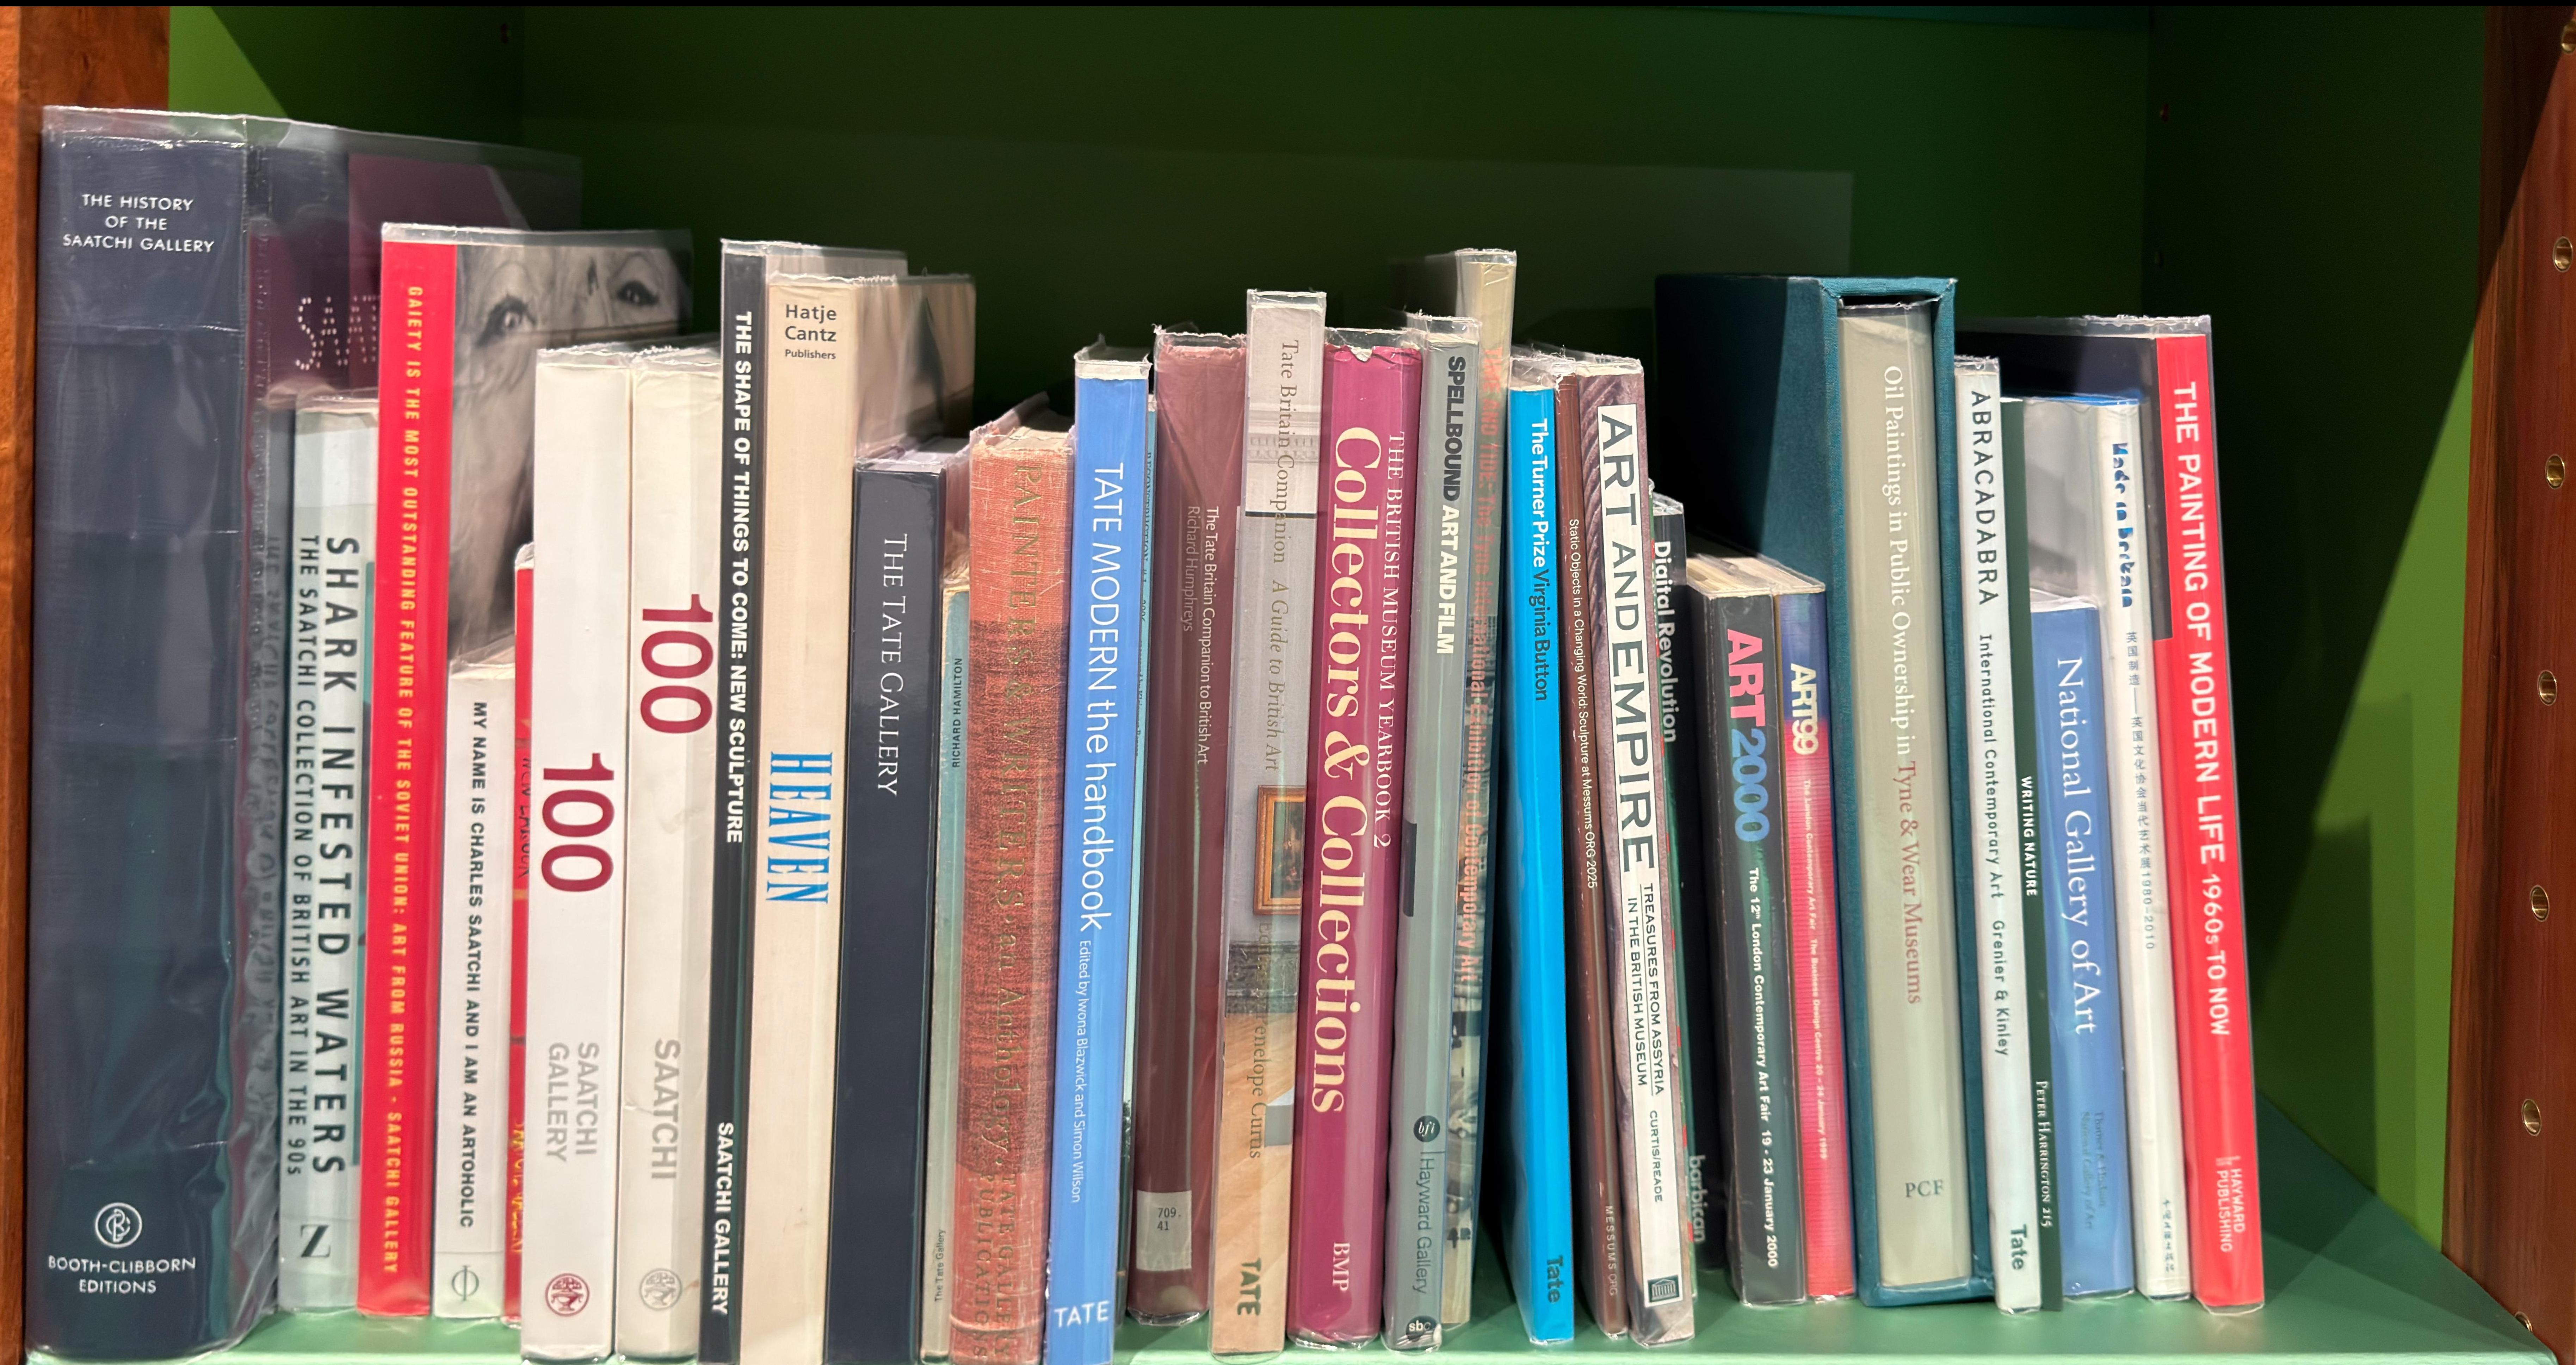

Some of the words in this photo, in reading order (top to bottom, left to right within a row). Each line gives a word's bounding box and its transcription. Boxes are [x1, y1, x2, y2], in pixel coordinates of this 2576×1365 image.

[82, 194, 112, 207] THE
[120, 196, 193, 211] HISTORY
[106, 217, 128, 229] OF
[136, 217, 167, 230] THE
[63, 235, 132, 249] SAATCHI
[141, 238, 214, 252] GALLERY
[735, 311, 752, 354] THE
[785, 304, 837, 322] Hatje
[785, 326, 837, 342] Cantz
[785, 348, 836, 360] Publishers
[734, 362, 752, 431] SHAPE
[1884, 365, 1904, 401] Oil
[1443, 356, 1466, 502] SPELLBOUND
[1532, 419, 1548, 455] The
[2174, 382, 2199, 443] THE
[734, 438, 750, 465] OF
[1388, 431, 1404, 480] THE
[1602, 413, 1637, 527] ART
[1882, 407, 1906, 506] Paintings
[732, 472, 750, 552] THINGS
[1093, 462, 1123, 532] TATE
[1532, 456, 1548, 517] Turner
[1972, 391, 1999, 605] ABRACADABRA
[1206, 506, 1219, 531] The
[1385, 488, 1402, 579] BRITISH
[1441, 505, 1459, 551] ART
[1532, 520, 1549, 568] Prize
[1570, 519, 1579, 550] Static
[1889, 511, 1907, 533] in
[2177, 455, 2207, 592] PAINTING
[301, 535, 319, 575] THE
[732, 559, 748, 586] TO
[883, 533, 908, 587] THE
[1205, 532, 1218, 561] Tate
[1326, 427, 1382, 717] Collectors
[1890, 539, 1911, 606] Public
[1204, 563, 1217, 607] Britain
[1439, 551, 1457, 599] AND
[1570, 553, 1581, 595] Objects
[1612, 541, 1639, 630] AND
[323, 537, 360, 692] SHARK
[730, 592, 748, 660] COME:
[1087, 543, 1121, 691] MODERN
[1437, 603, 1455, 654] FILM
[1528, 569, 1550, 637] Virginia
[1574, 598, 1582, 607] in
[2186, 602, 2211, 641] OF
[298, 589, 319, 686] SAATCHI
[882, 595, 906, 664] TATE
[1199, 609, 1215, 684] Companion
[1380, 587, 1400, 690] MUSEUM
[1574, 620, 1584, 672] Changing
[640, 593, 714, 734] 100
[730, 666, 746, 713] NEW
[953, 657, 963, 715] HAMILTON
[1534, 640, 1550, 702] Button
[1658, 622, 1680, 743] Revolution
[1891, 611, 1915, 730] Ownership
[1980, 634, 1996, 742] International
[473, 702, 487, 728] MY
[1199, 686, 1210, 699] to
[1577, 674, 1588, 709] World:
[2189, 652, 2219, 782] MODERN
[878, 672, 903, 797] GALLERY
[953, 719, 962, 768] RICHARD
[1086, 700, 1118, 753] the
[1199, 702, 1211, 741] British
[1578, 711, 1589, 763] Sculpture
[1897, 736, 1915, 755] in
[2057, 657, 2090, 798] National
[294, 701, 316, 841] COLLECTION
[472, 736, 487, 789] NAME
[727, 719, 746, 843] SCULPTURE
[1198, 745, 1210, 764] Art
[1325, 730, 1370, 780] &
[1375, 698, 1395, 822] YEARBOOK
[1581, 766, 1589, 776] at
[1612, 640, 1655, 872] EMPIRE
[471, 797, 485, 814] IS
[1582, 779, 1592, 828] Messums
[1893, 761, 1916, 812] Tyne
[1985, 749, 2000, 865] Contemporary
[2021, 777, 2034, 838] WRITING
[318, 726, 356, 955] INFESTED
[541, 752, 615, 892] 100
[766, 751, 833, 904] HEAVEN
[1080, 762, 1116, 932] handbook
[1374, 834, 1391, 848] 2
[1585, 830, 1596, 857] ORG
[1901, 819, 1919, 837] &
[2197, 795, 2224, 864] LIFE
[293, 855, 312, 881] OF
[469, 823, 485, 907] CHARLES
[1587, 860, 1597, 888] 2025
[1902, 843, 1920, 897] Wear
[1991, 872, 2003, 898] Art
[2024, 841, 2038, 897] NATURE
[2061, 811, 2095, 927] Gallery
[1628, 898, 1637, 912] IN
[1643, 883, 1658, 977] TREASURES
[2202, 873, 2224, 944] 1960s
[291, 895, 311, 982] BRITISH
[467, 914, 483, 993] SAATCHI
[1312, 797, 1368, 1113] Collections
[1629, 920, 1639, 947] THE
[1904, 903, 1922, 1005] Museums
[1993, 920, 2007, 982] Grenier
[2070, 940, 2101, 977] of
[1631, 953, 1643, 1014] BRITISH
[2206, 950, 2226, 979] TO
[290, 996, 309, 1036] ART
[465, 1000, 479, 1037] AND
[1650, 982, 1660, 1025] FROM
[1995, 990, 2007, 1000] &
[2073, 981, 2101, 1035] Art
[2209, 987, 2230, 1036] NOW
[1634, 1018, 1647, 1086] MUSEUM
[1995, 1007, 2010, 1056] Kinley
[290, 1051, 308, 1073] IN
[313, 988, 349, 1173] WATERS
[464, 1057, 478, 1084] AM
[1652, 1029, 1664, 1095] ASSYRIA
[288, 1086, 308, 1125] THE
[463, 1092, 476, 1116] AN
[546, 1042, 570, 1162] GALLERY
[575, 1042, 600, 1155] SAATCHI
[651, 1038, 681, 1179] SAATCHI
[1418, 1122, 1435, 1135] bfi
[287, 1139, 305, 1174] 90s
[459, 1126, 476, 1229] ARTOHOLIC
[715, 1122, 734, 1212] SAATCHI
[1650, 1110, 1663, 1202] CURTIS/READE
[1416, 1158, 1434, 1230] Hayward
[1690, 1155, 1705, 1243] barbican
[1905, 1180, 1944, 1197] PCF
[2217, 1170, 2232, 1252] PUBLISHING
[2231, 1168, 2245, 1233] HAYWARD
[1157, 1221, 1169, 1231] 41
[2011, 1224, 2027, 1270] Tate
[48, 1255, 196, 1273] BOOTH-CLIBBORN
[79, 1279, 156, 1293] EDITIONS
[711, 1219, 731, 1316] GALLERY
[1237, 1258, 1261, 1316] TATE
[1332, 1242, 1350, 1291] BMP
[1412, 1237, 1432, 1294] Gallery
[1547, 1255, 1563, 1304] Tate
[1054, 1301, 1111, 1329] TATE
